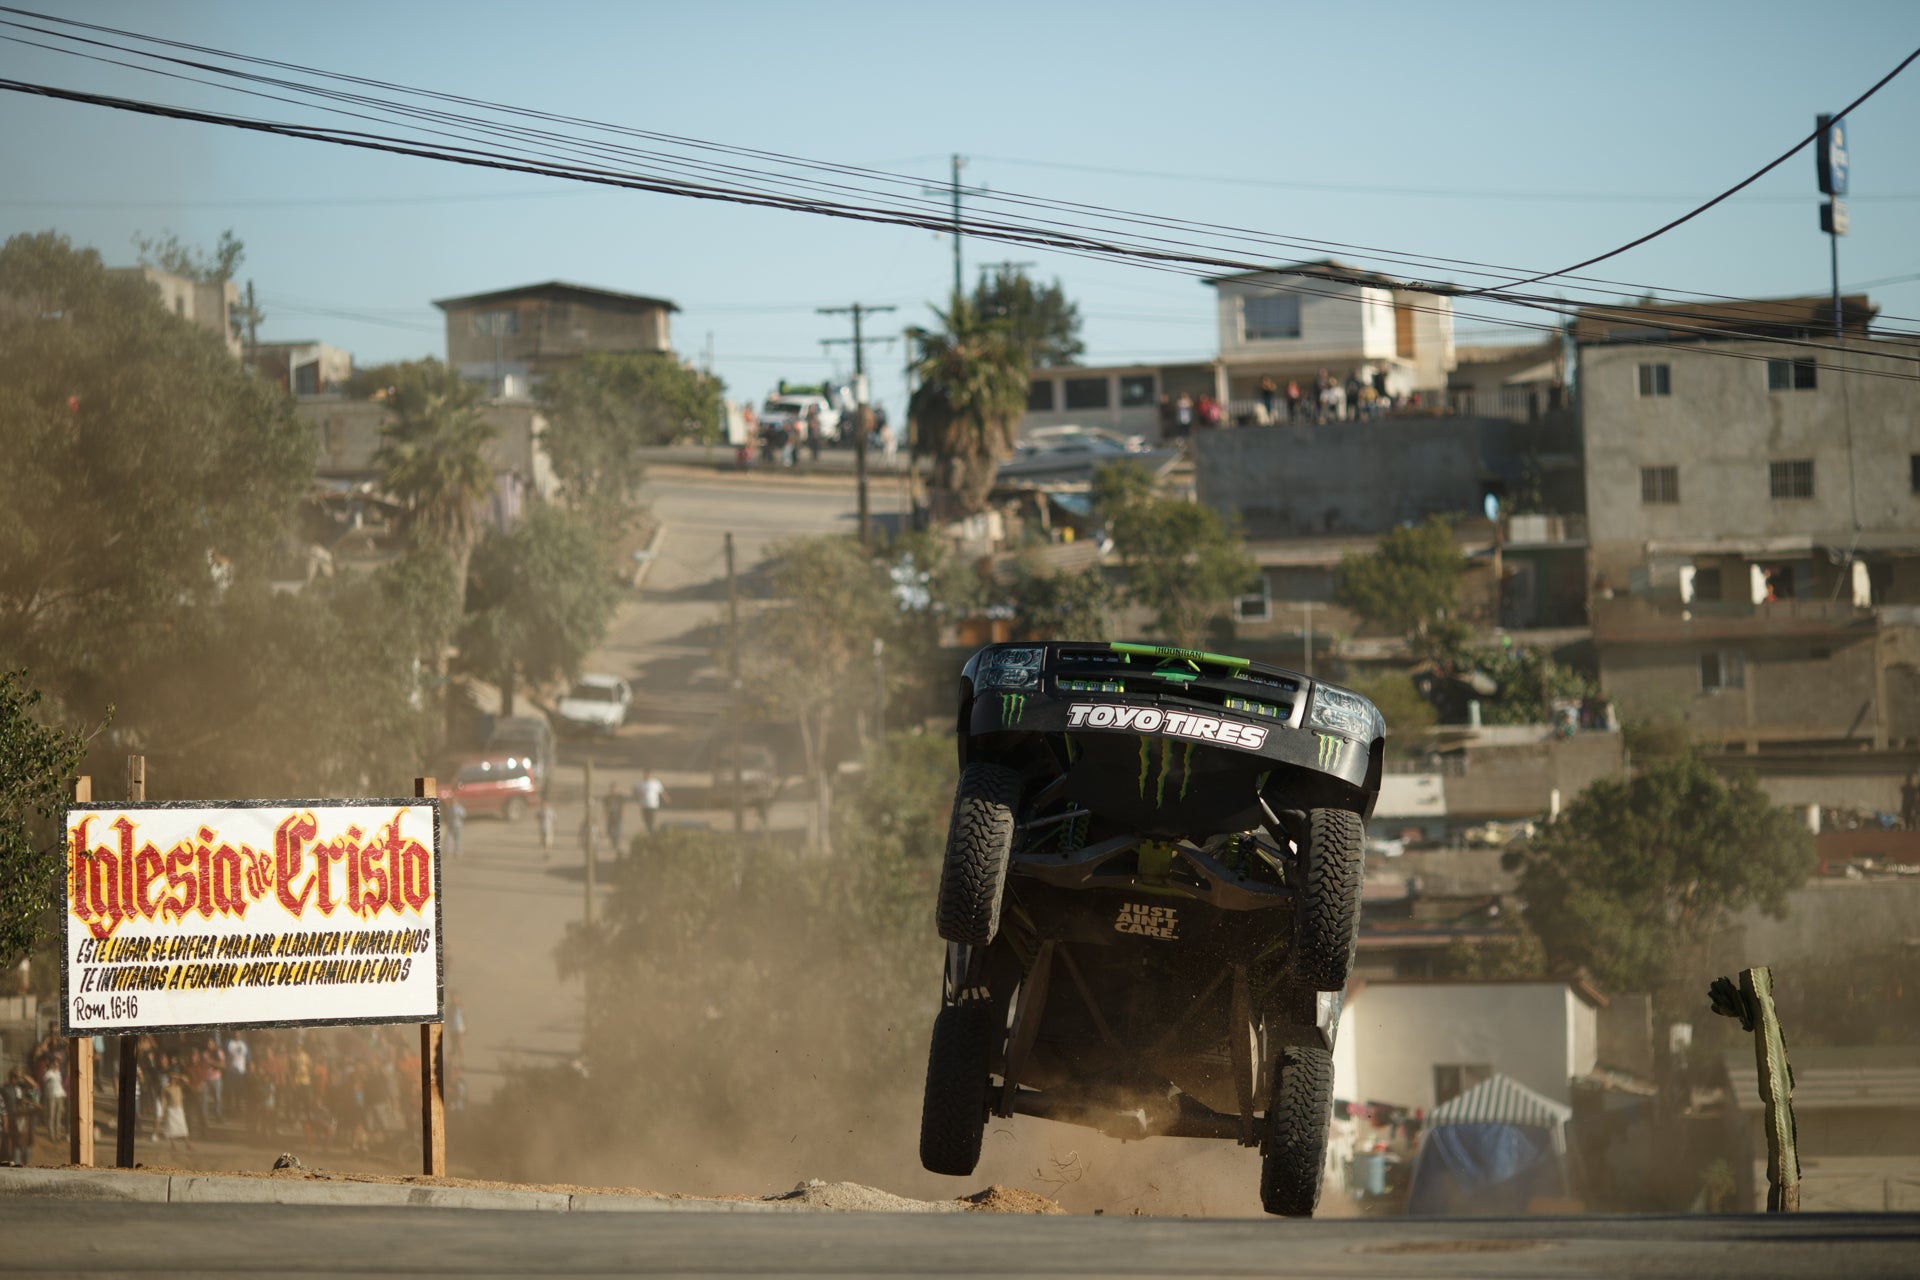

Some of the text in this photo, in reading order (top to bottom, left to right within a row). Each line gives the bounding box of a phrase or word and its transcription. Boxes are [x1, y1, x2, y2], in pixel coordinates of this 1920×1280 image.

[1067, 703, 1269, 750] TOYO TIRES
[67, 806, 434, 940] Iglesia de Cristo
[1115, 912, 1179, 929] AIN'T
[1119, 903, 1177, 919] JUST
[76, 927, 430, 964] ESTE LUGAR SE EDIFICA PARA DAR ALABANZA Y HONRA A DIOS
[80, 956, 412, 994] TE INVITAMOS A FORMAR PARTE DE LA FAMILIA DE DIOS
